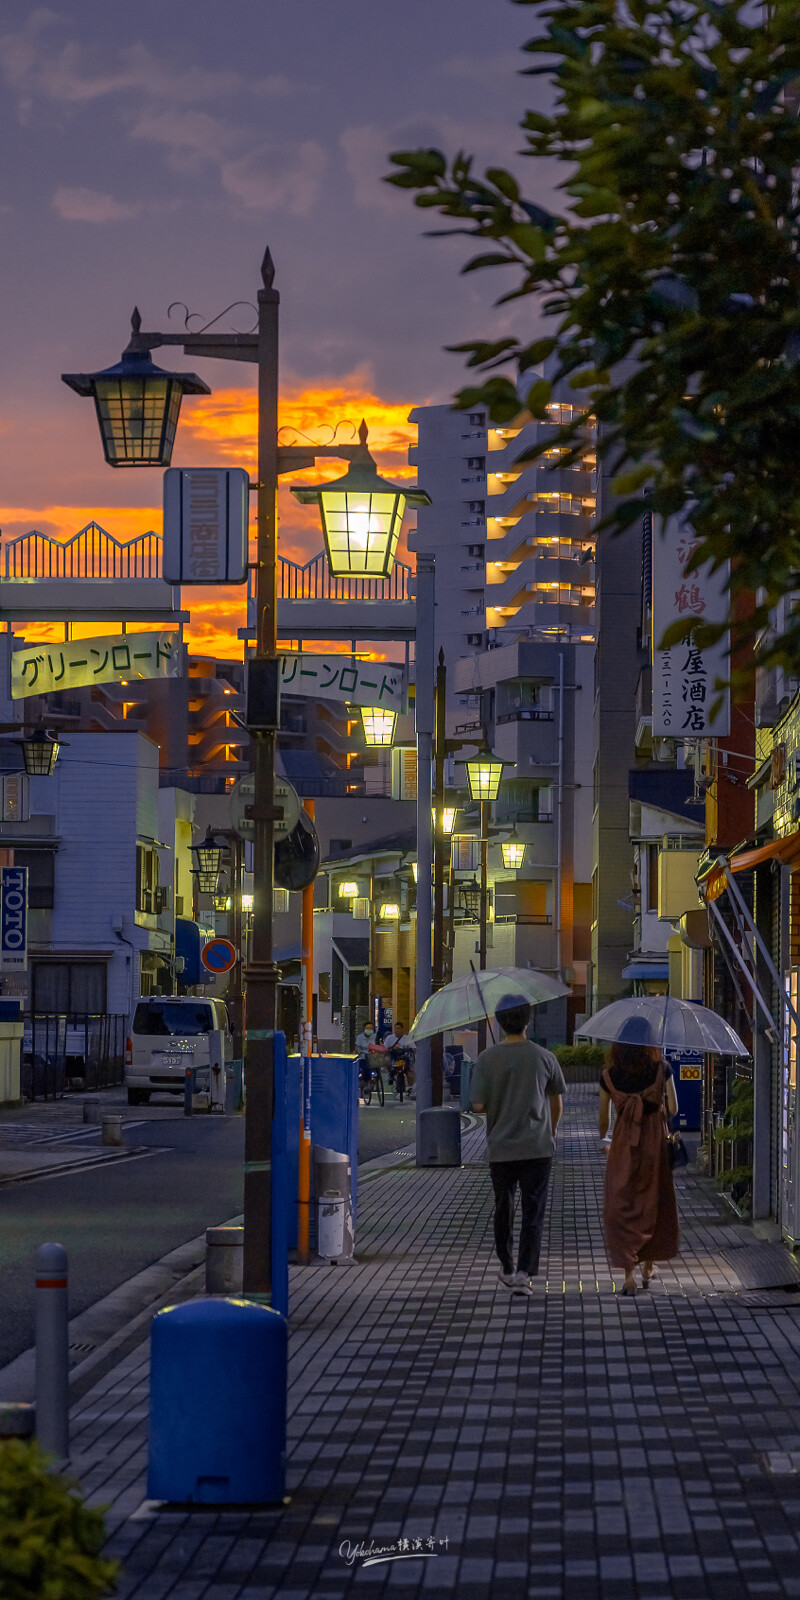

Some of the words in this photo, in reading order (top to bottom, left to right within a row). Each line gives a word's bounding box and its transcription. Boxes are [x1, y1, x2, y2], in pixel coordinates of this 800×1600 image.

[21, 641, 172, 687] グリーンロード
[281, 655, 397, 700] リーンロード
[4, 873, 24, 949] TOTO
[681, 1069, 700, 1079] 100
